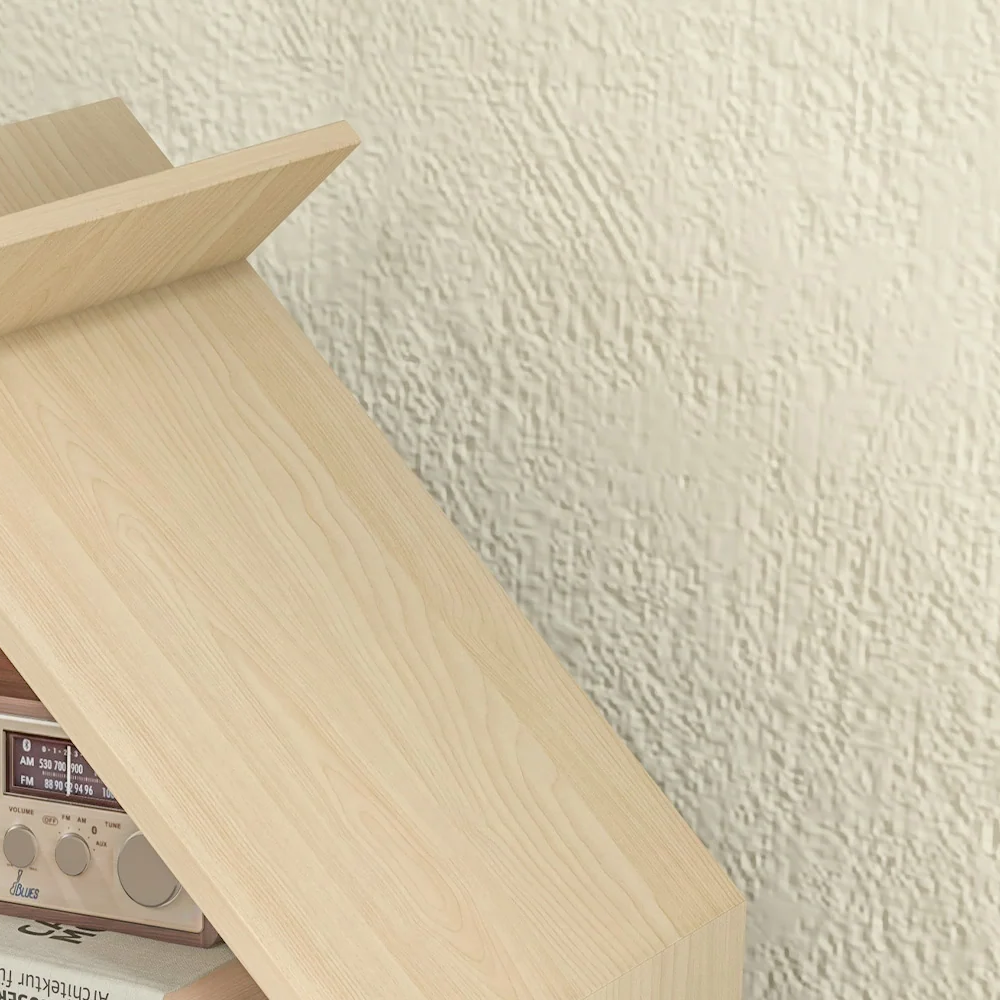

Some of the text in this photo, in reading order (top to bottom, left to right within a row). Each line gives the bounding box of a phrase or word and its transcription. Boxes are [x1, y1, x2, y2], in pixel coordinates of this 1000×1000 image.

[20, 756, 84, 775] AM 530 700 900
[20, 775, 34, 786] FM
[44, 779, 54, 790] 88
[54, 780, 63, 791] 90
[74, 784, 83, 795] 94
[84, 785, 94, 796] 96
[9, 806, 34, 815] VOLUME
[44, 816, 56, 824] OFF
[105, 821, 121, 829] TUNE
